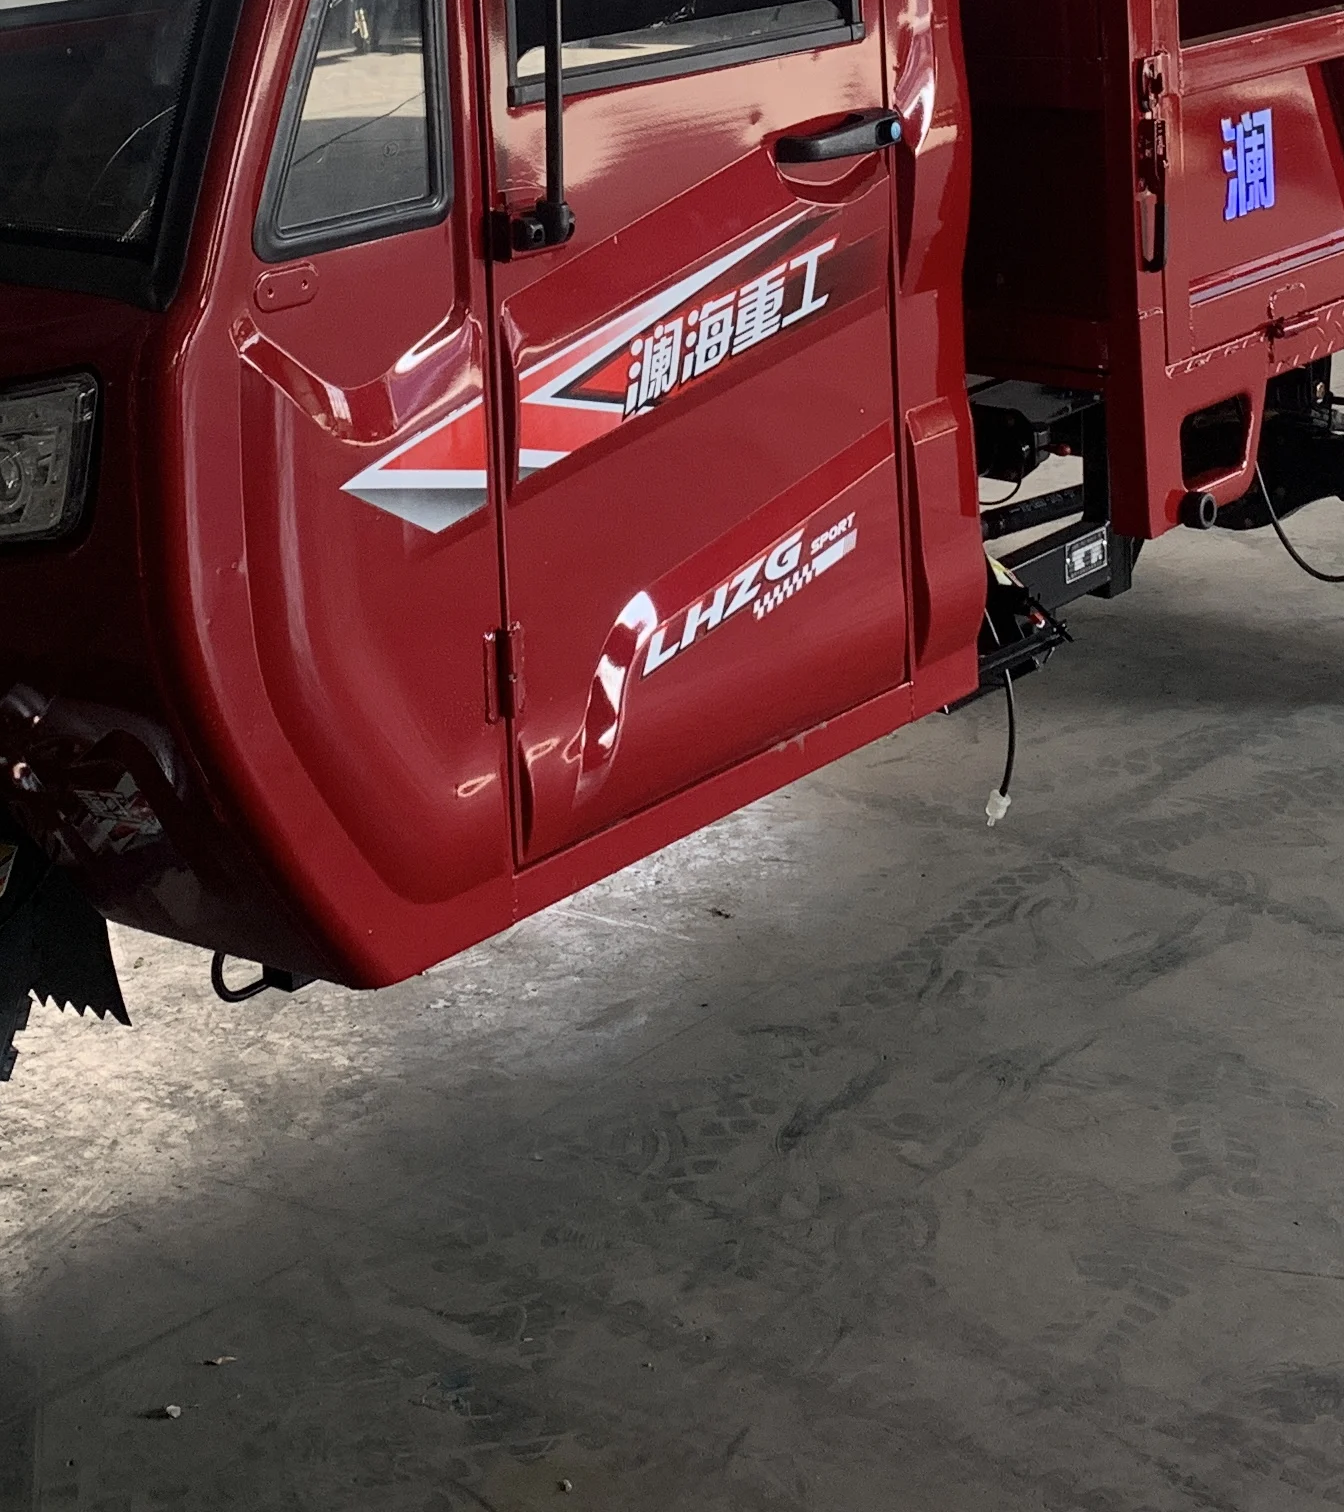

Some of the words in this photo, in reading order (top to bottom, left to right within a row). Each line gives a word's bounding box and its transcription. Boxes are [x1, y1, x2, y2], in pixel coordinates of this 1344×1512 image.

[1220, 107, 1275, 221] 澜
[622, 236, 839, 417] 澜海重工
[643, 527, 805, 677] LHZG
[810, 510, 856, 556] SPORT
